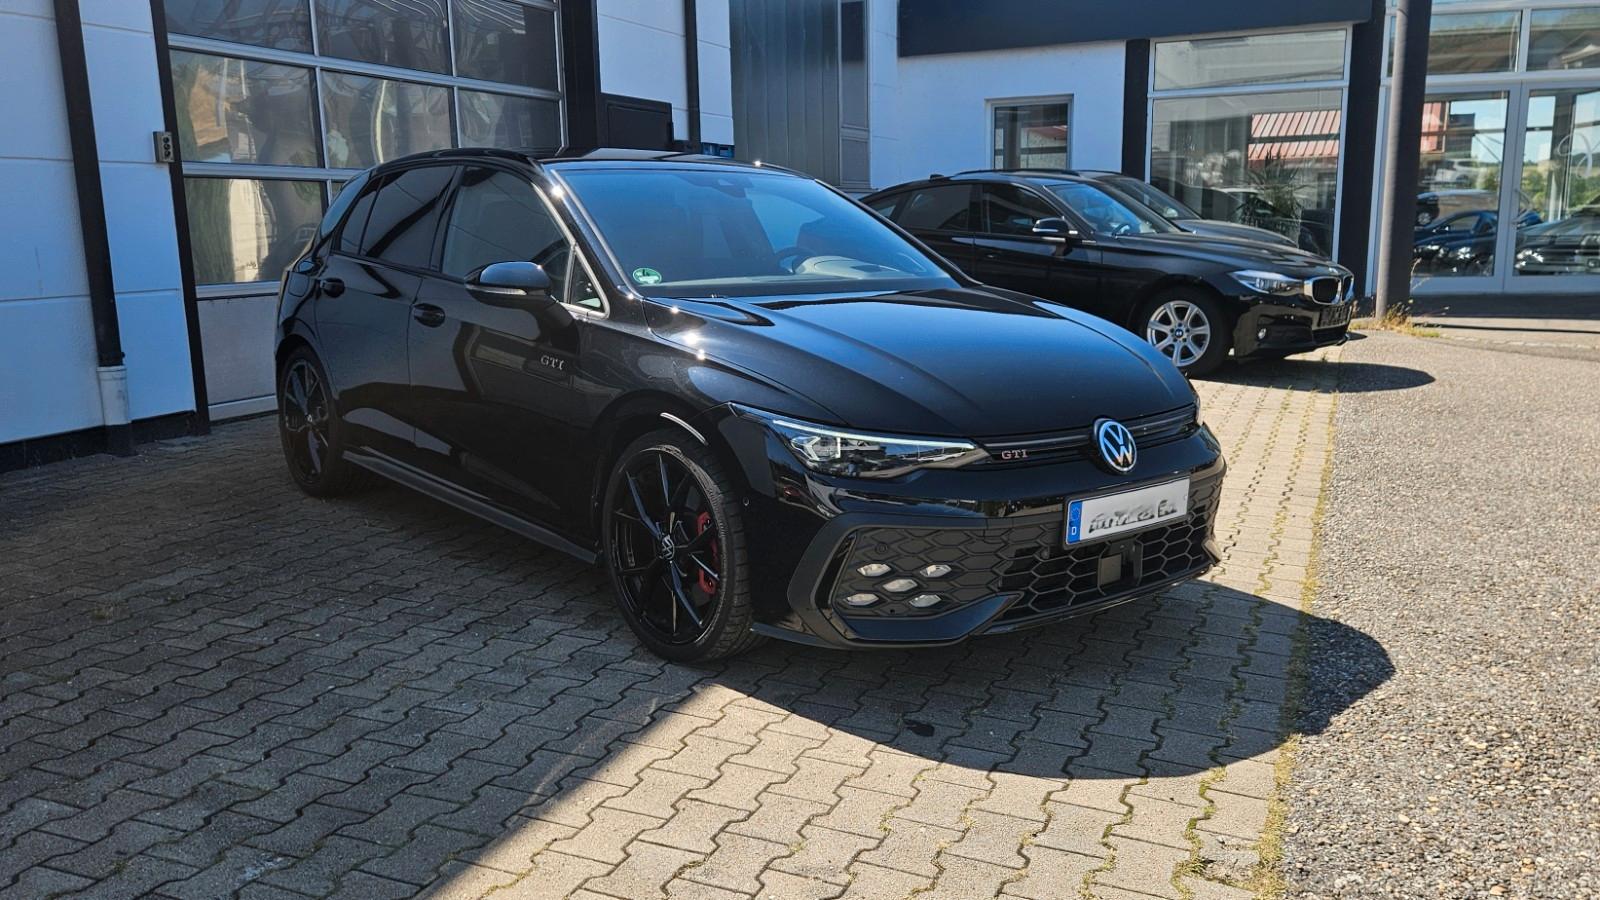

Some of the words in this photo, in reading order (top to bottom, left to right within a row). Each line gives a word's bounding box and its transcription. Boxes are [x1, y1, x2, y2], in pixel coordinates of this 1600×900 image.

[540, 354, 565, 371] GTI
[1100, 422, 1136, 470] VW
[1001, 449, 1028, 460] GTI
[1071, 526, 1077, 535] D
